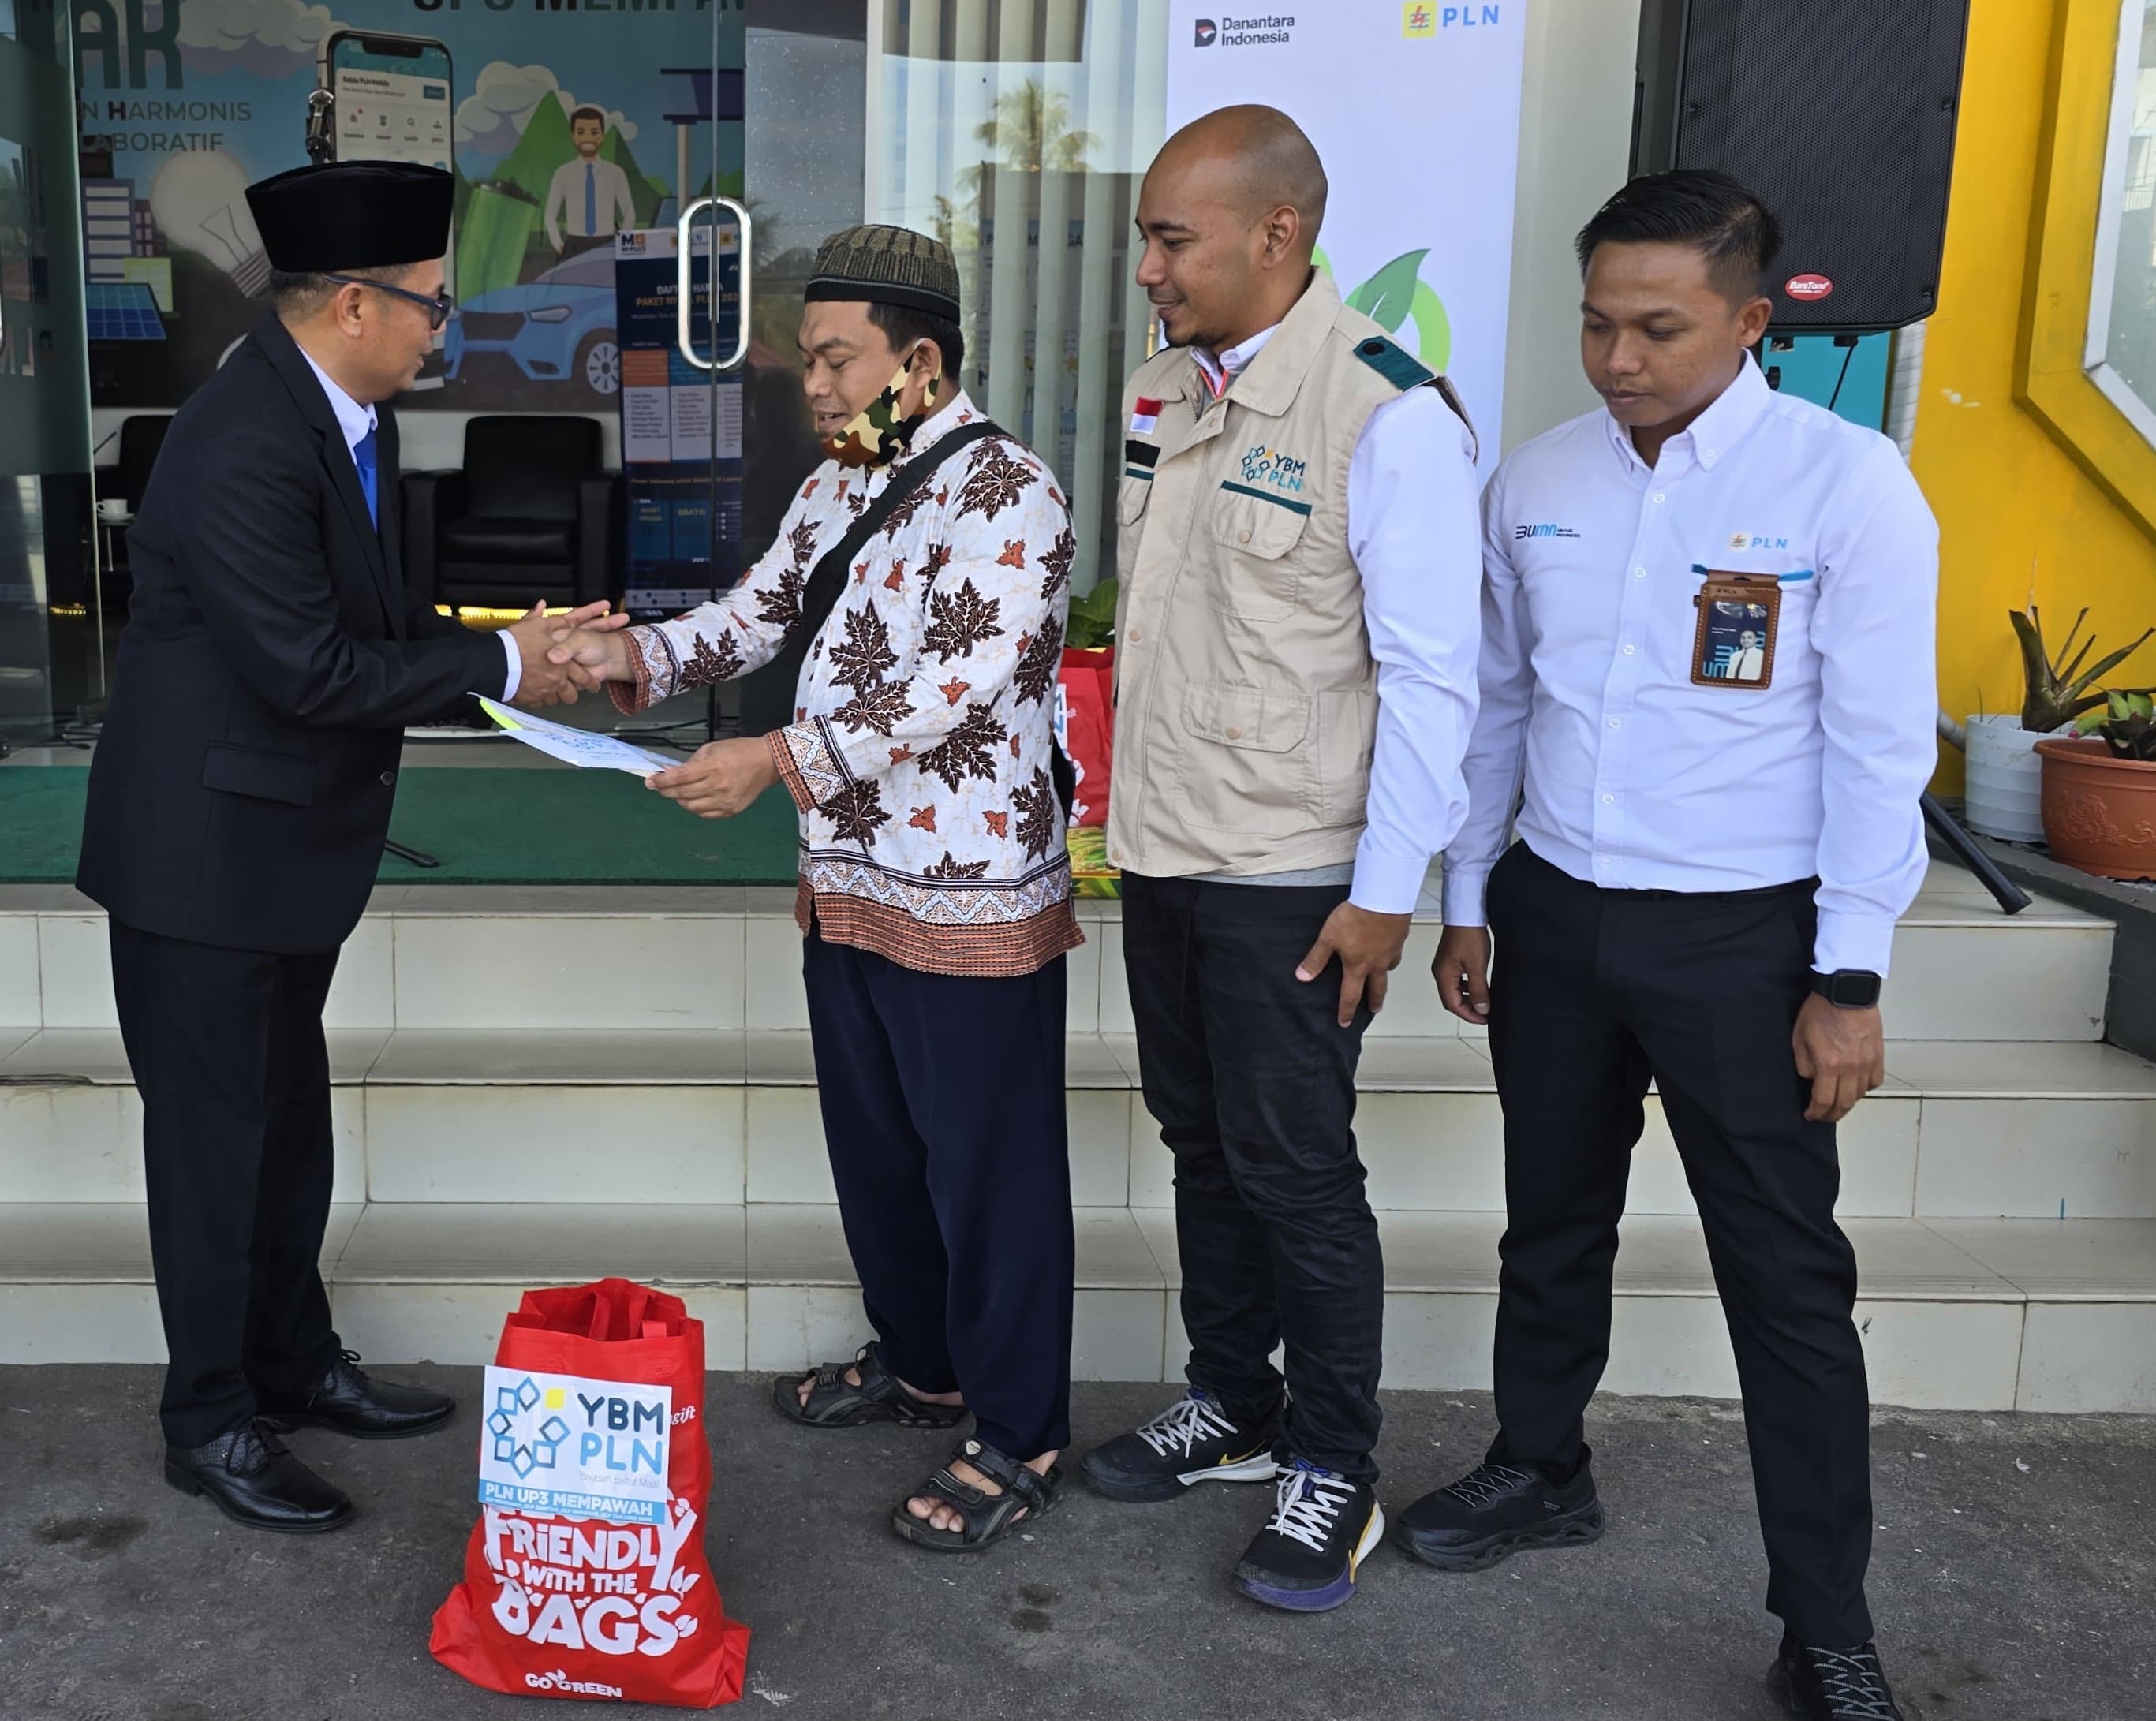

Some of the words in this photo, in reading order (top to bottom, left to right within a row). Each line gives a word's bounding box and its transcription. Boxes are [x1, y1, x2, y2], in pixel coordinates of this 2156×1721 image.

[1221, 14, 1295, 31] Danantara
[1442, 4, 1500, 28] PLN
[1220, 30, 1291, 47] Indonesia
[108, 100, 252, 121] HARMONIS
[1275, 454, 1306, 477] YBM
[1268, 469, 1302, 492] PLN
[1751, 536, 1788, 550] PLN
[577, 1392, 664, 1435] YBM
[580, 1432, 663, 1475] PLN
[486, 1482, 514, 1500] PLN
[517, 1487, 550, 1506] UP3
[555, 1491, 653, 1517] MEMPAWAH
[591, 1572, 638, 1595] THE
[525, 1671, 553, 1689] GO
[558, 1681, 622, 1698] GREEN
